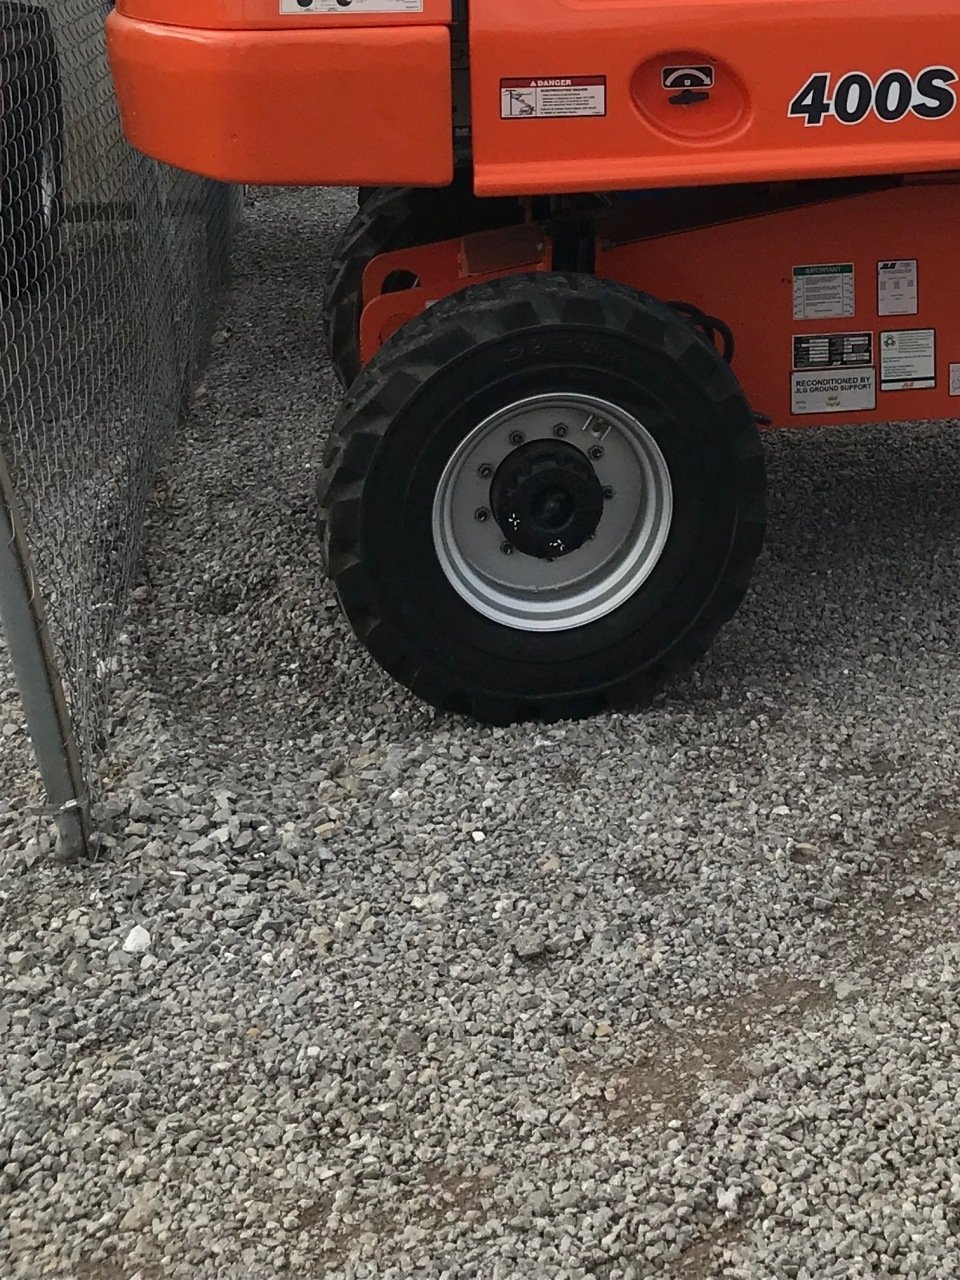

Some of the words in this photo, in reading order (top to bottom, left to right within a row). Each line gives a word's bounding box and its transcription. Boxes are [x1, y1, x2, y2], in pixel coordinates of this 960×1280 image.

[788, 67, 958, 126] 400S
[805, 266, 841, 274] IMPORTANT
[796, 377, 858, 387] RECONDITIONED
[809, 385, 839, 393] GROUND
[840, 383, 871, 391] SUPPORT
